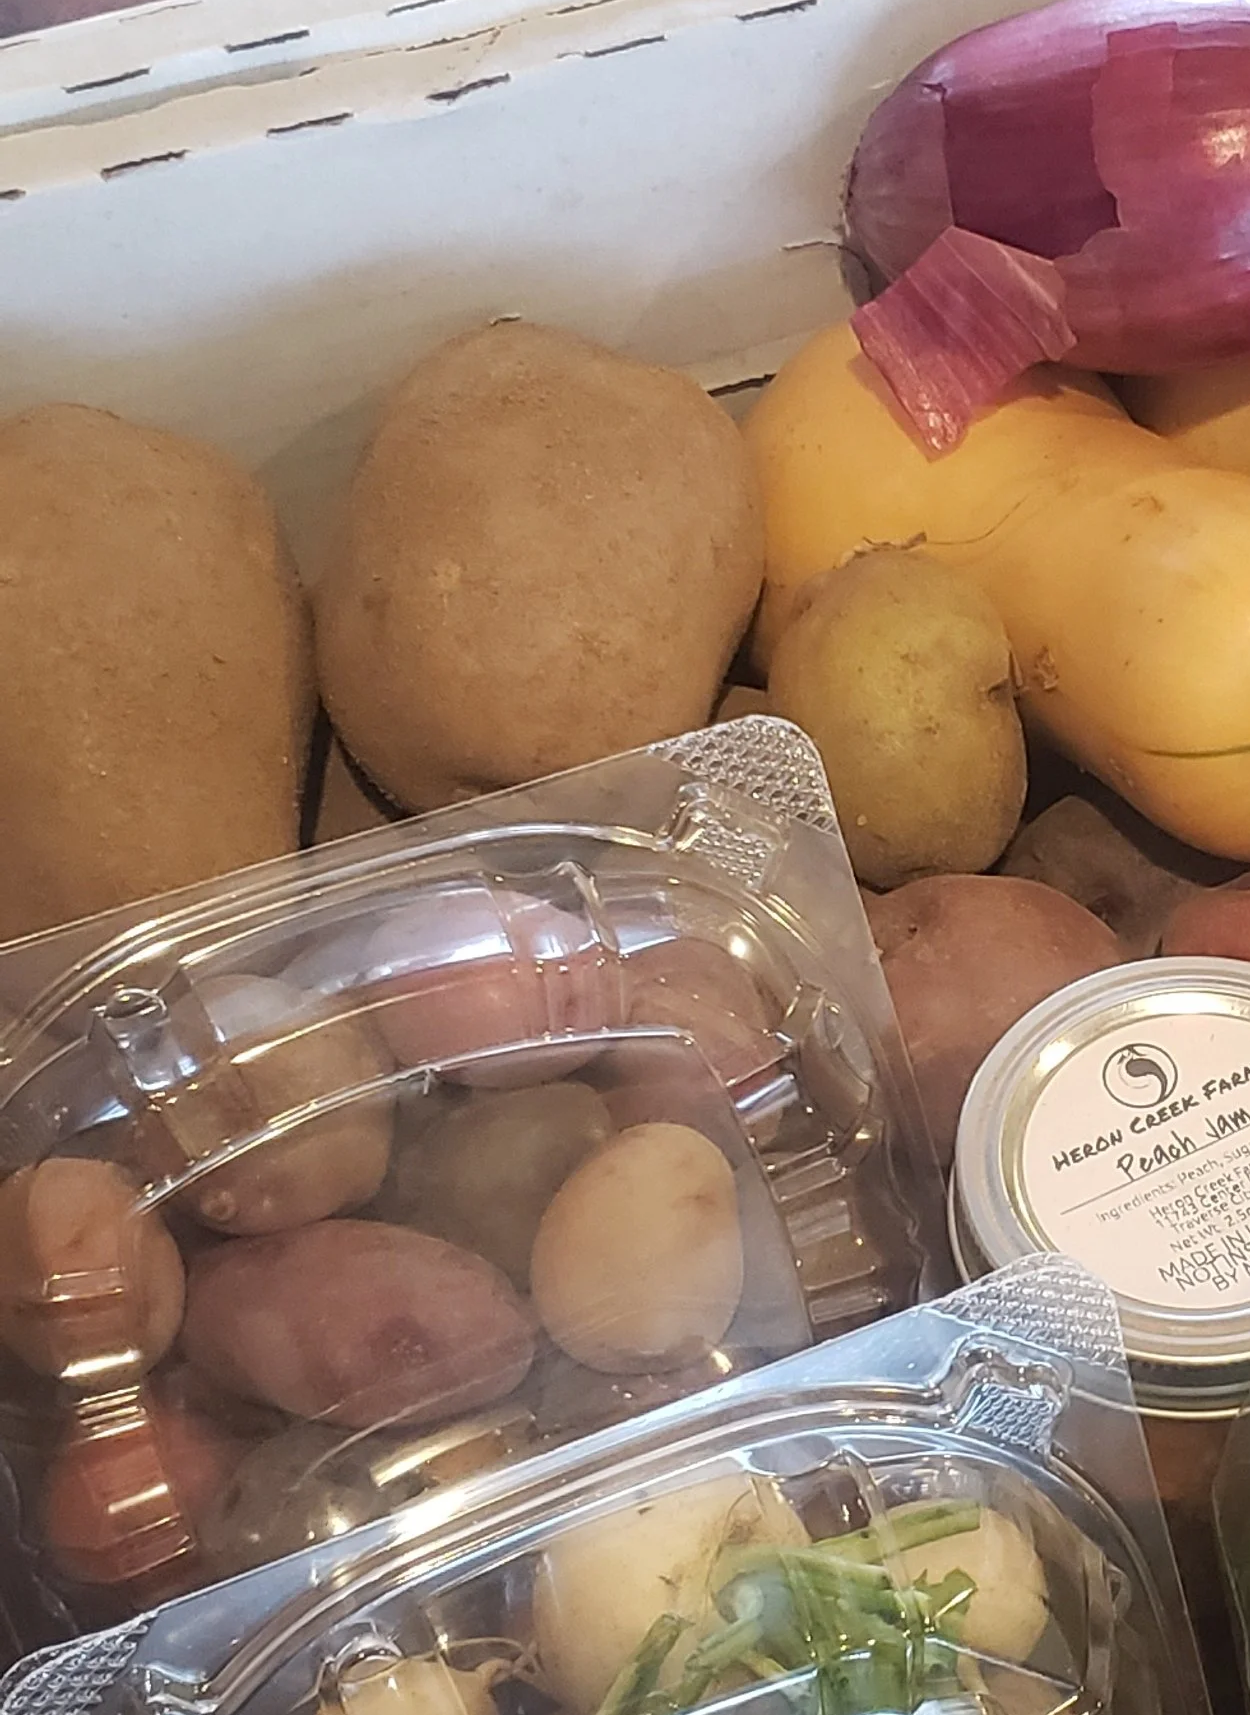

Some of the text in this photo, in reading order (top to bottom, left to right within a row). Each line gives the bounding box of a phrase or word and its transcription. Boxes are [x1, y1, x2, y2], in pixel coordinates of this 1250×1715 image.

[1051, 1128, 1124, 1172] HERON
[1129, 1093, 1200, 1135] CREEK
[1116, 1129, 1197, 1182] Peach
[1097, 1179, 1176, 1223] Ingredients:
[1158, 1243, 1221, 1283] MADE
[1220, 1229, 1246, 1254] IN
[1175, 1255, 1221, 1293] NOT
[1211, 1266, 1239, 1292] BY
